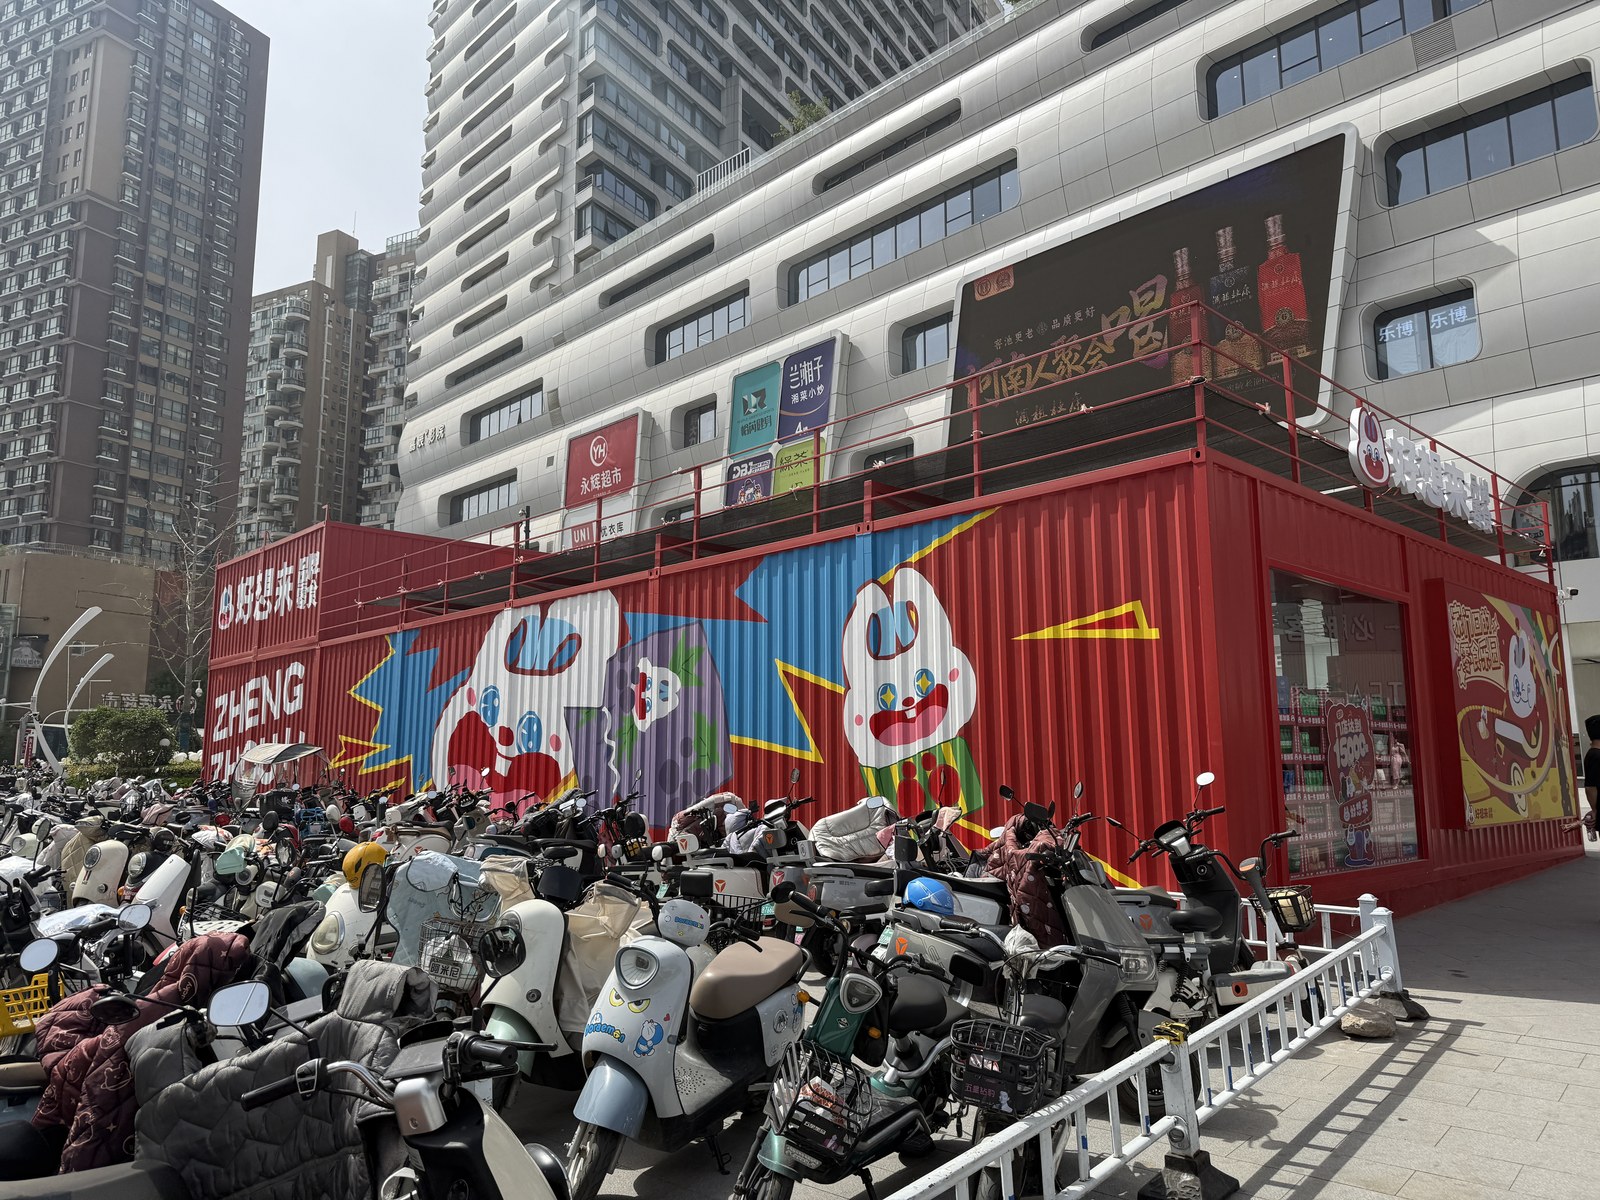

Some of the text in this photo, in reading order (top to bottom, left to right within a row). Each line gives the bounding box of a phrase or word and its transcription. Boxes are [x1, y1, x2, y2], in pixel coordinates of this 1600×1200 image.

[1050, 305, 1096, 331] 品质更好
[1429, 305, 1467, 329] 乐博
[1378, 319, 1414, 342] 乐博
[789, 355, 824, 389] 兰湘子
[791, 384, 825, 405] 湘菜小炒
[592, 442, 606, 460] YH
[580, 467, 622, 495] 永辉超市
[573, 526, 590, 543] UNI
[235, 561, 294, 624] 好想来
[212, 661, 306, 743] ZHENG
[1335, 718, 1362, 739] 门店达到
[430, 962, 460, 979] 阿米尼
